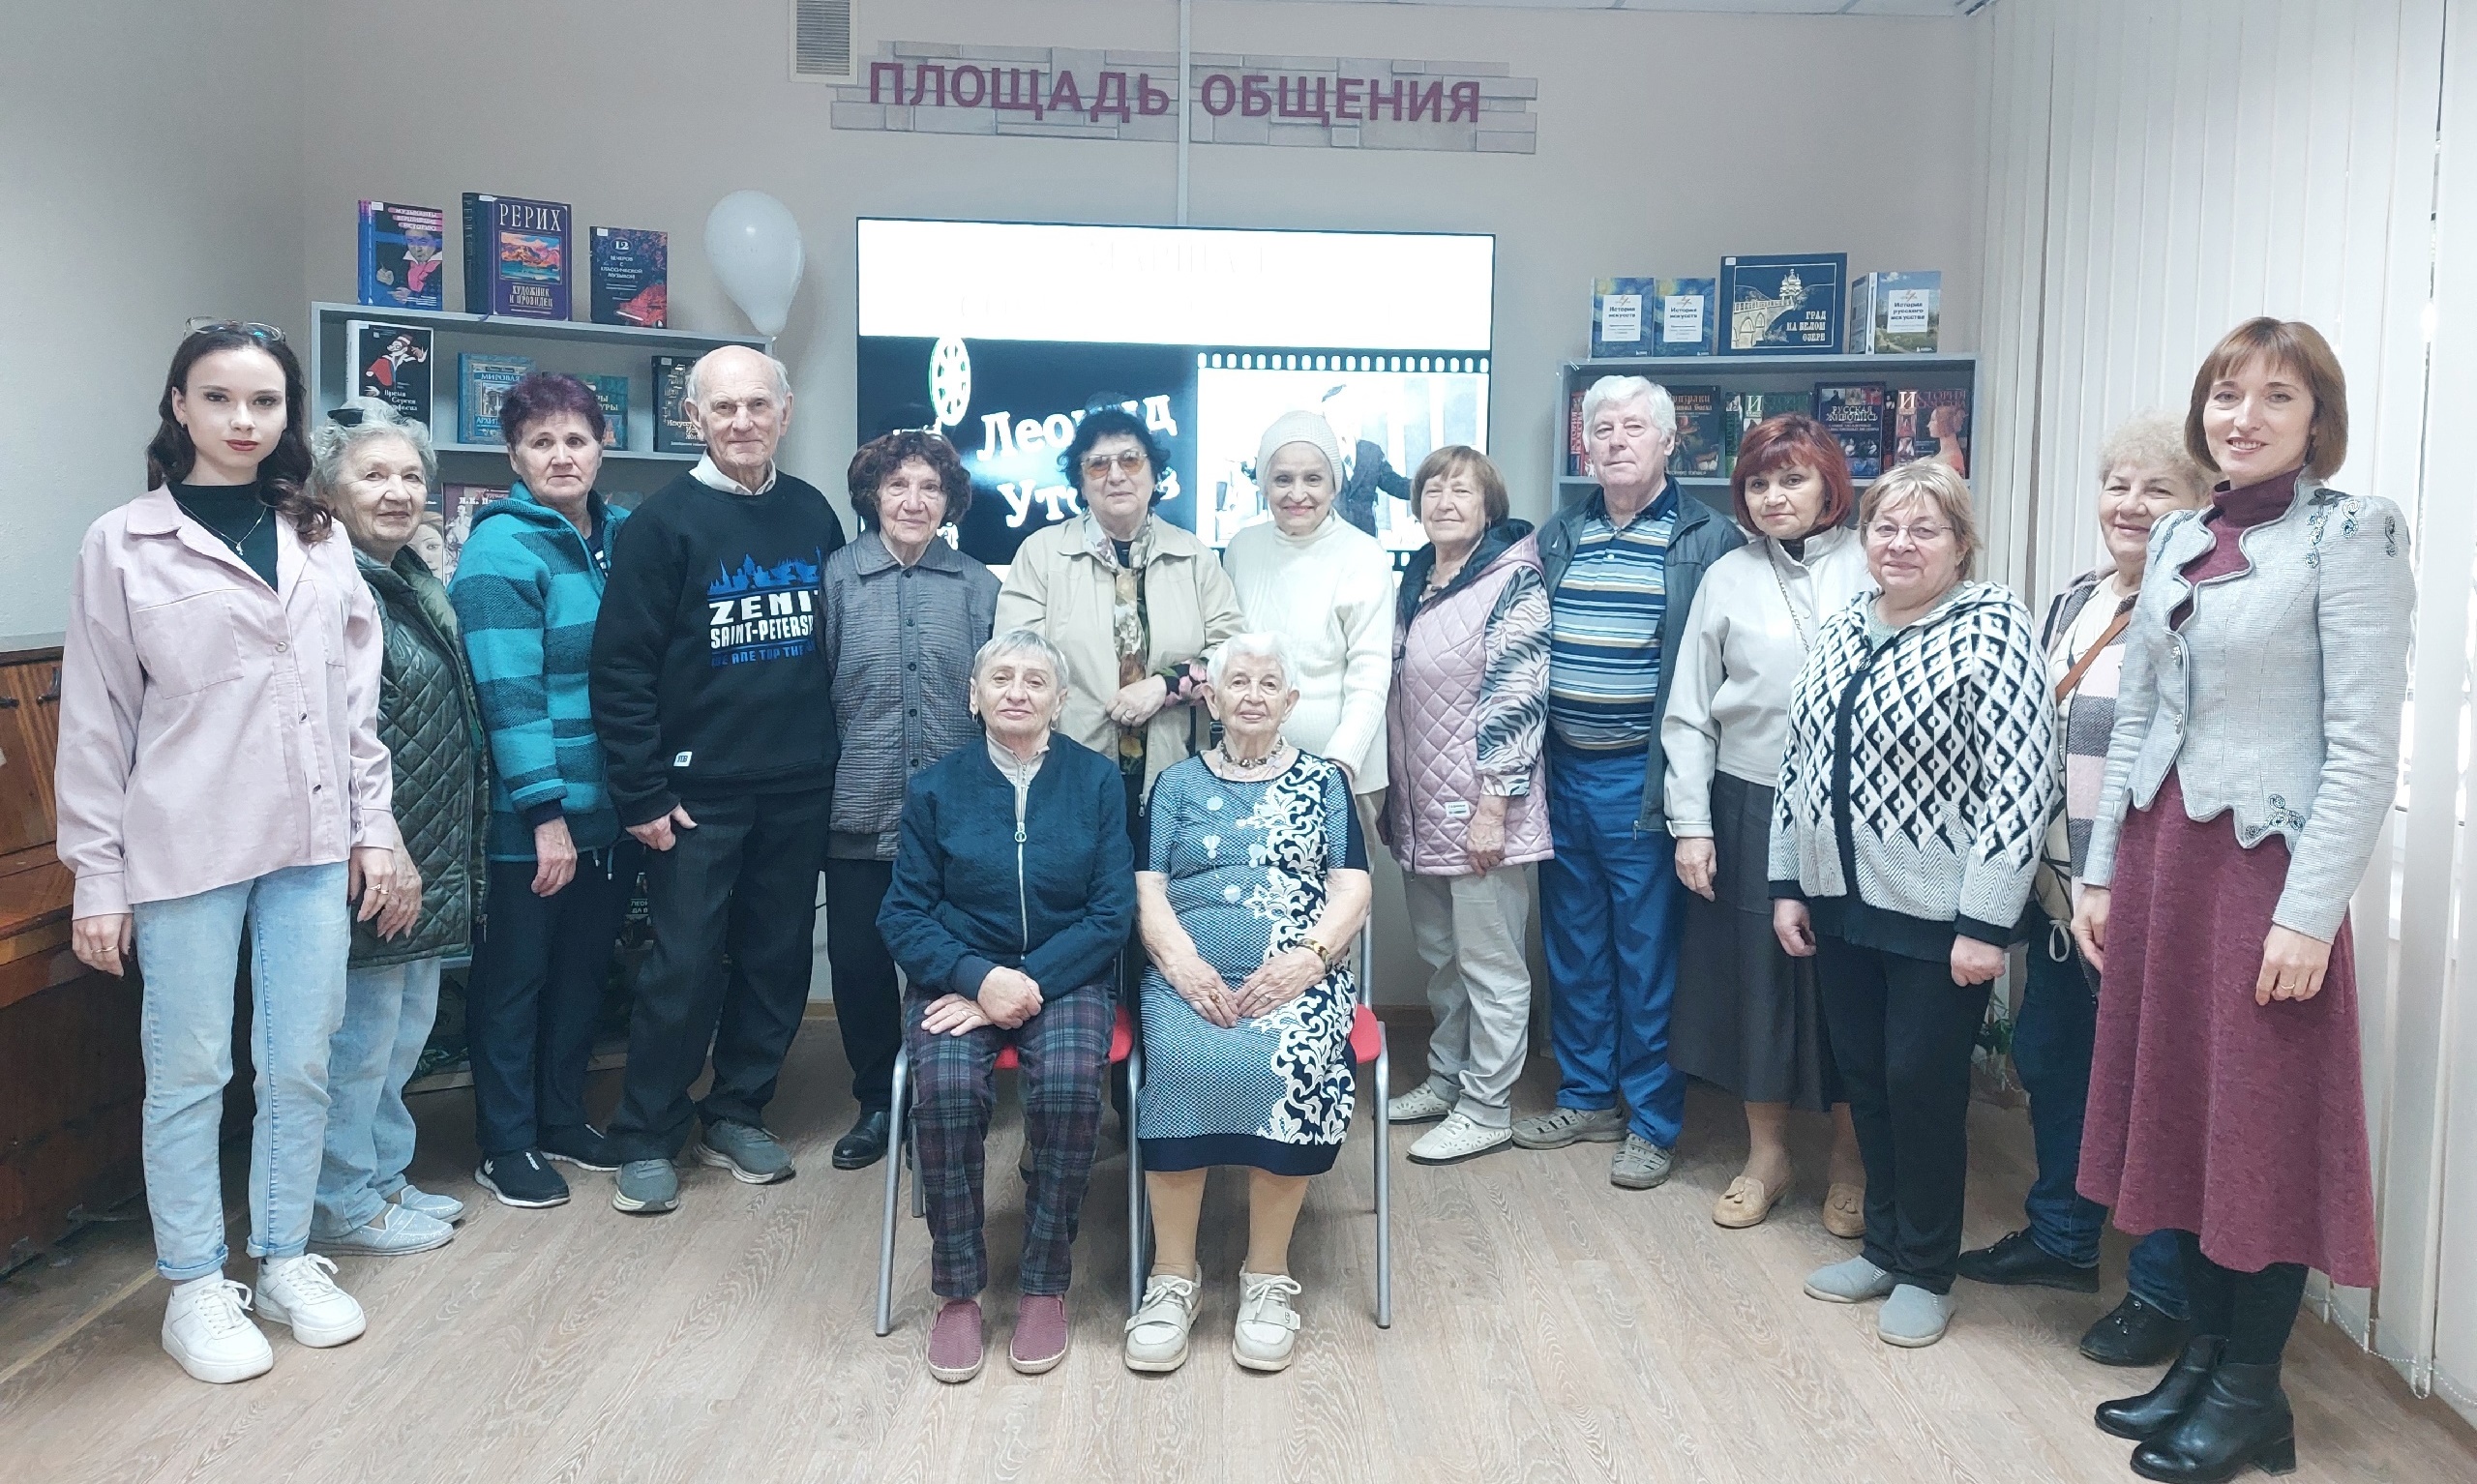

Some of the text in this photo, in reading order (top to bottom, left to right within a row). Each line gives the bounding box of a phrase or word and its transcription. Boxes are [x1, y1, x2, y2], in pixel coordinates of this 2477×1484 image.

[871, 62, 1480, 128] ПЛОЩАДЬ ОБЩЕНИЯ
[499, 203, 561, 231] РЕРИХ
[614, 241, 630, 251] 12
[512, 285, 550, 297] ХУДОЖНИК
[509, 294, 552, 307] И ПРОВИДЕЦ
[1806, 311, 1827, 320] ГРАД
[1786, 321, 1826, 331] НА БЕЛОМ
[1802, 333, 1826, 342] ОЗЕРЕ
[480, 372, 521, 382] МИРОВАЯ
[1832, 405, 1873, 414] РУССКАЯ
[1826, 413, 1878, 422] ЖИВОПИСЬ
[709, 589, 819, 626] ZENI
[731, 650, 756, 665] ARE
